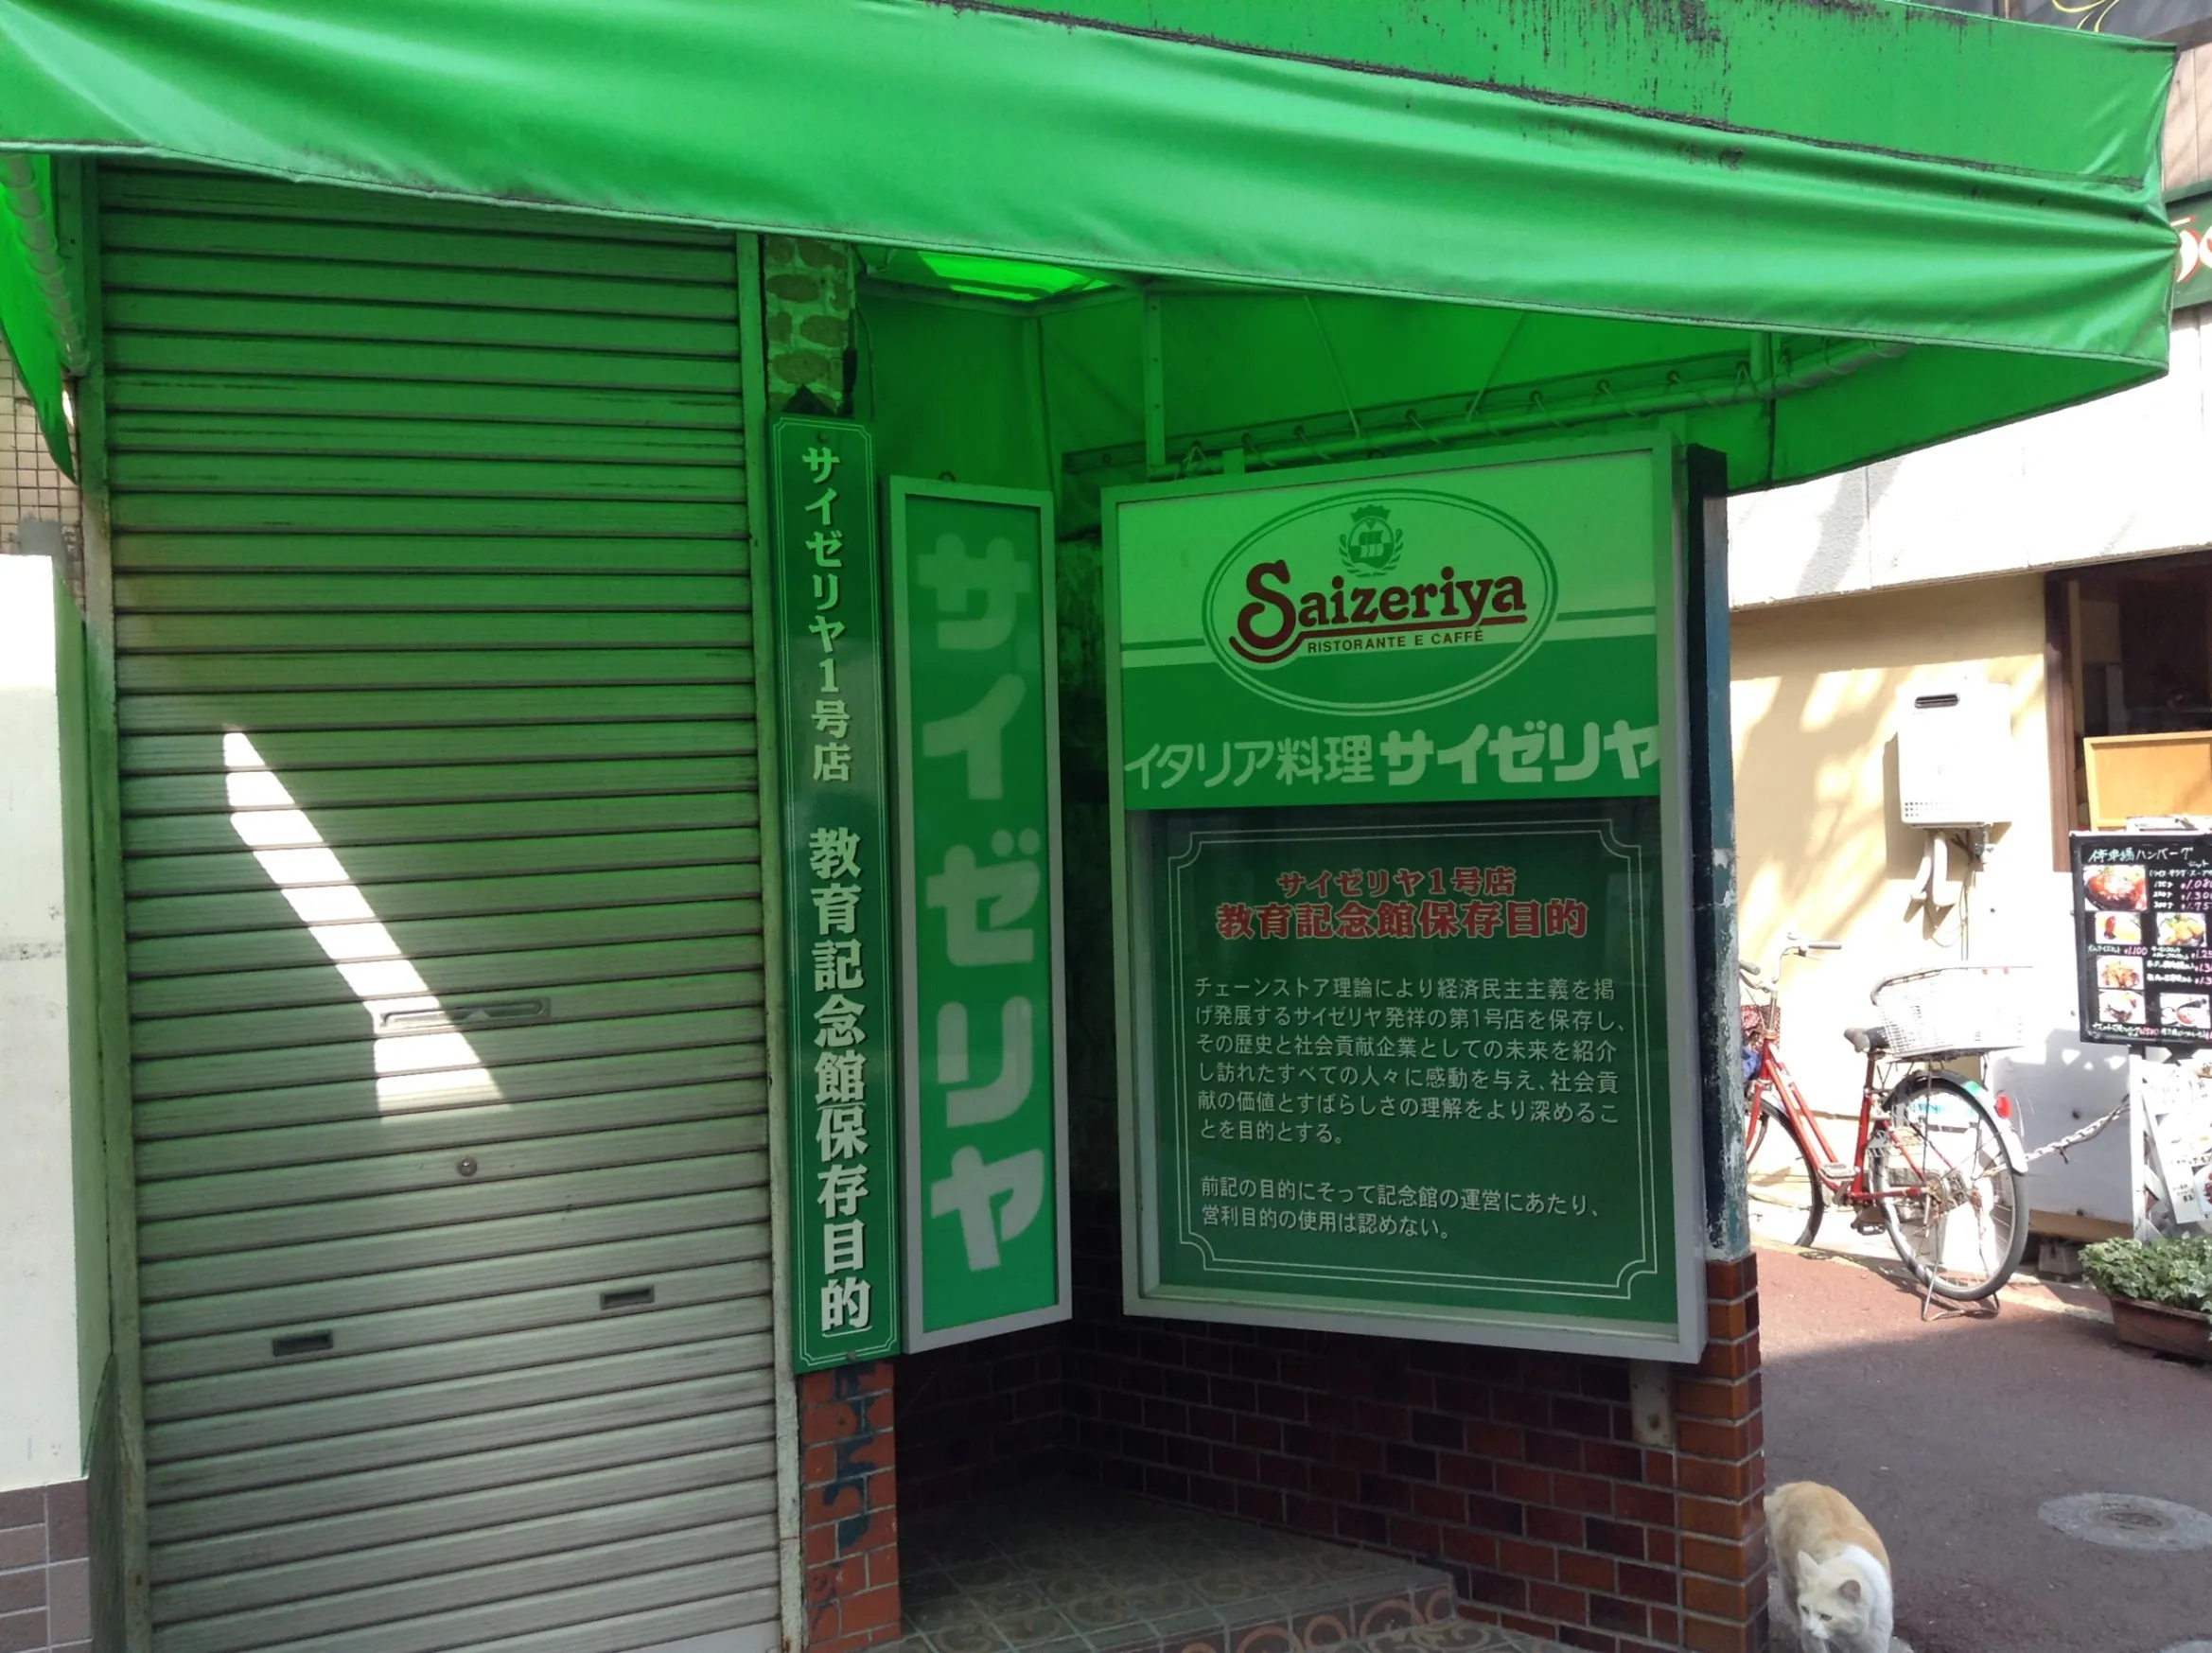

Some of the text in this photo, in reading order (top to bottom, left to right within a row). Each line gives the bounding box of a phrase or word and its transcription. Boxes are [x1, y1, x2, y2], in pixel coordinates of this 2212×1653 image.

[1232, 558, 1528, 660] Saizeriya
[1308, 635, 1406, 654] RISTORANTE
[1414, 635, 1424, 646] E
[802, 447, 871, 1334] サイゼリヤ1号店 教育記念館保存目的
[1277, 867, 1518, 898] サイゼリヤ1号店
[917, 533, 1045, 1273] サイゼリヤ
[1215, 898, 1590, 940] 教育記念館保存目的
[1197, 1033, 1617, 1064] その歴史と社会貢献企業としての未来を紹介
[1201, 1118, 1342, 1145] とを目的とする。
[1203, 1205, 1448, 1240] 営利目的の使用は認めない。
